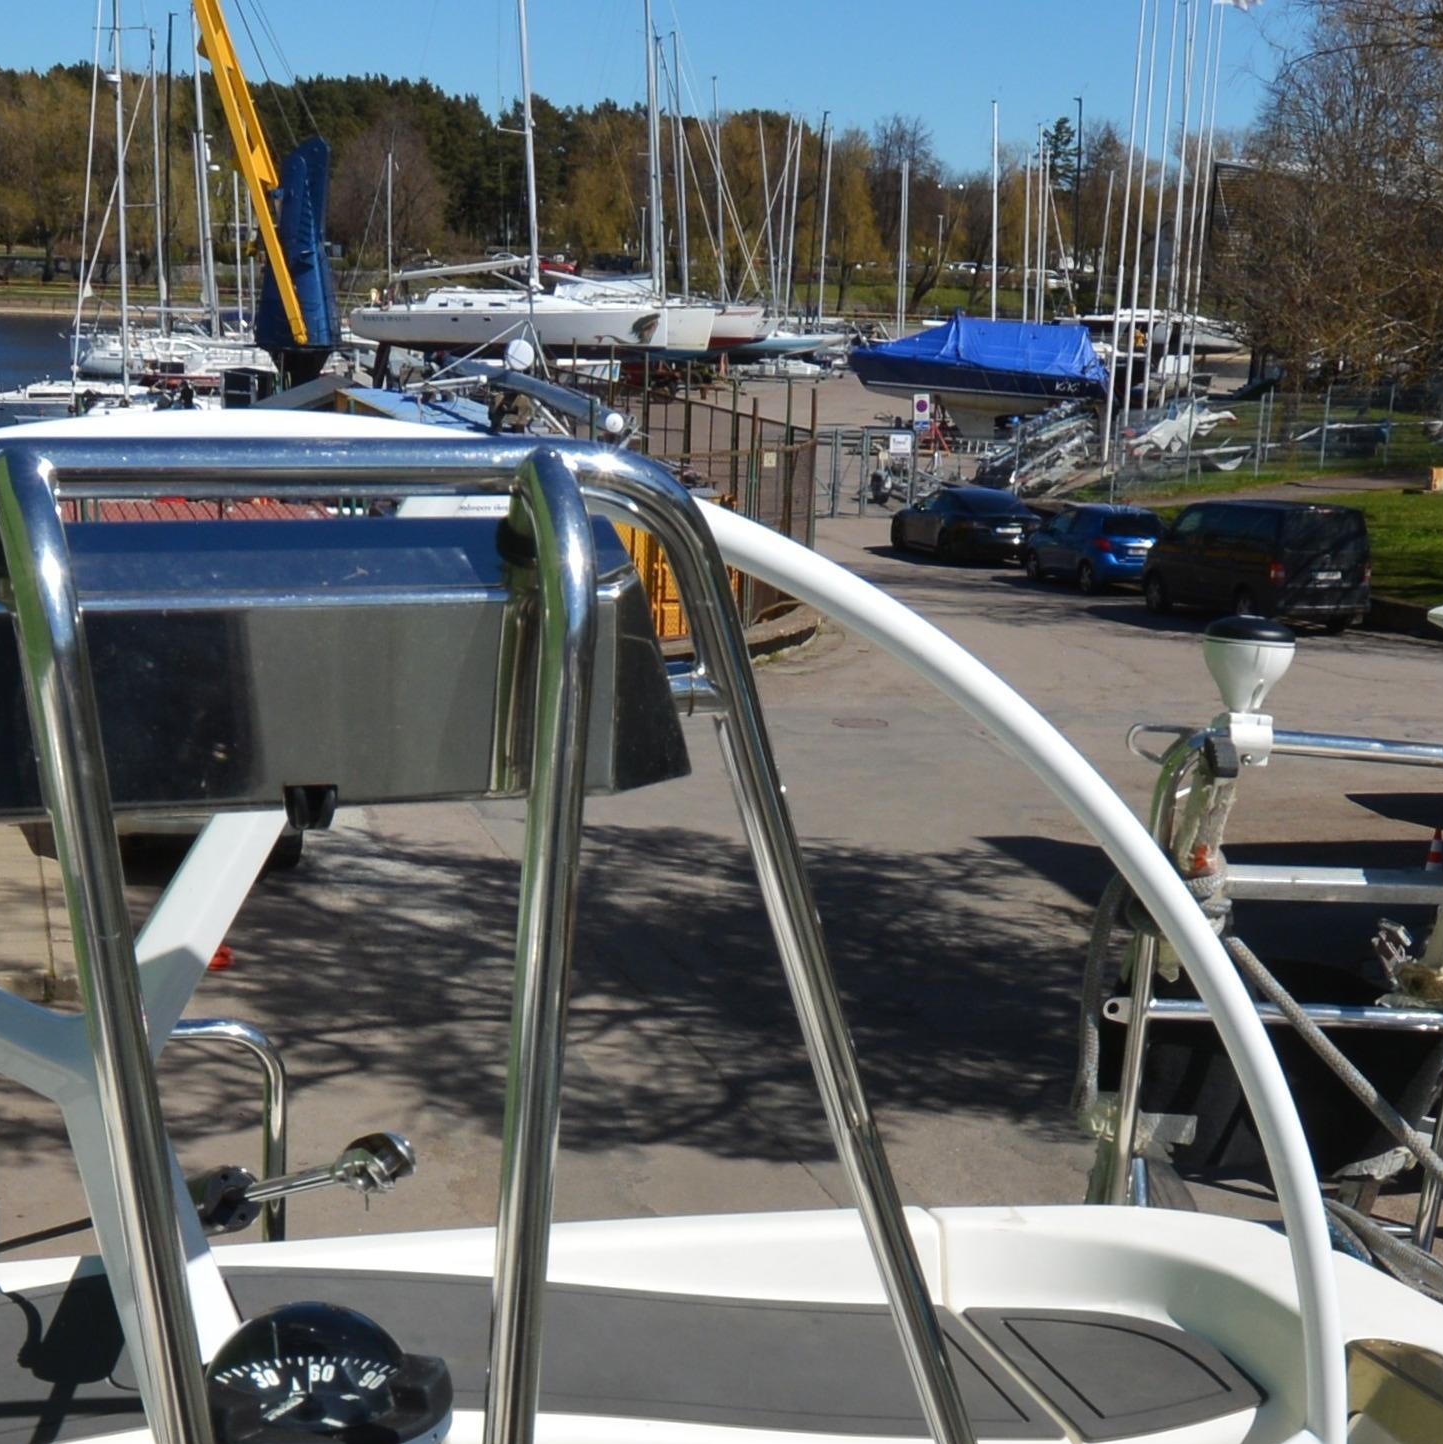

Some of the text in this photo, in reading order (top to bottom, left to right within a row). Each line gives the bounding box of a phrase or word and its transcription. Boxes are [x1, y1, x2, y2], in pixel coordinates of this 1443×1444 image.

[250, 1363, 387, 1390] 30 60 90
